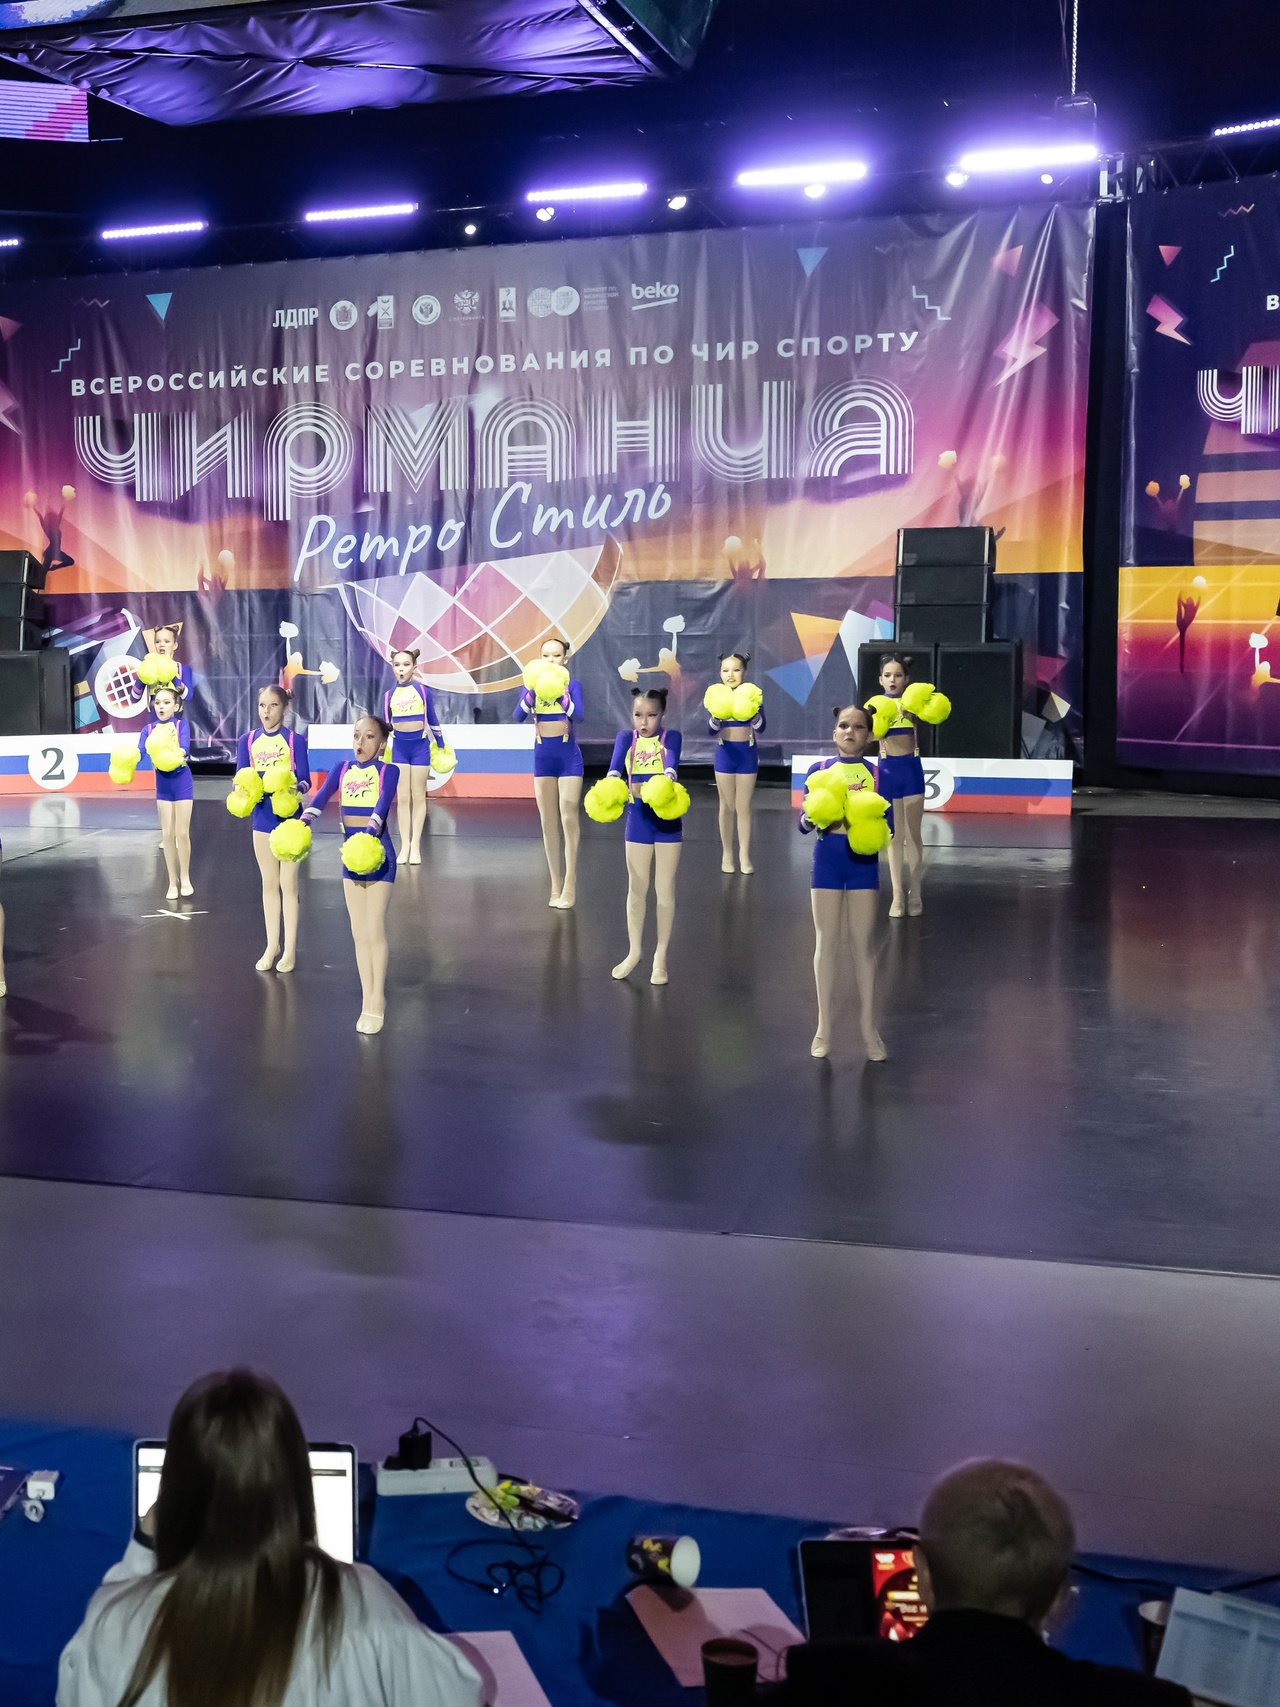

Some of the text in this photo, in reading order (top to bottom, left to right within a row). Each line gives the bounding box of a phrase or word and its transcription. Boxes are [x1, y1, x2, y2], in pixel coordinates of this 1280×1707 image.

[631, 281, 680, 300] beko
[273, 307, 319, 330] ЛДПР
[71, 330, 921, 397] ВСЕРОССИЙСКИЕ СОРЕВНОВАНИЯ ПО ЧИР СПОРТУ
[293, 481, 672, 583] Ретро Стиль
[41, 747, 65, 780] 2
[923, 769, 941, 800] 3
